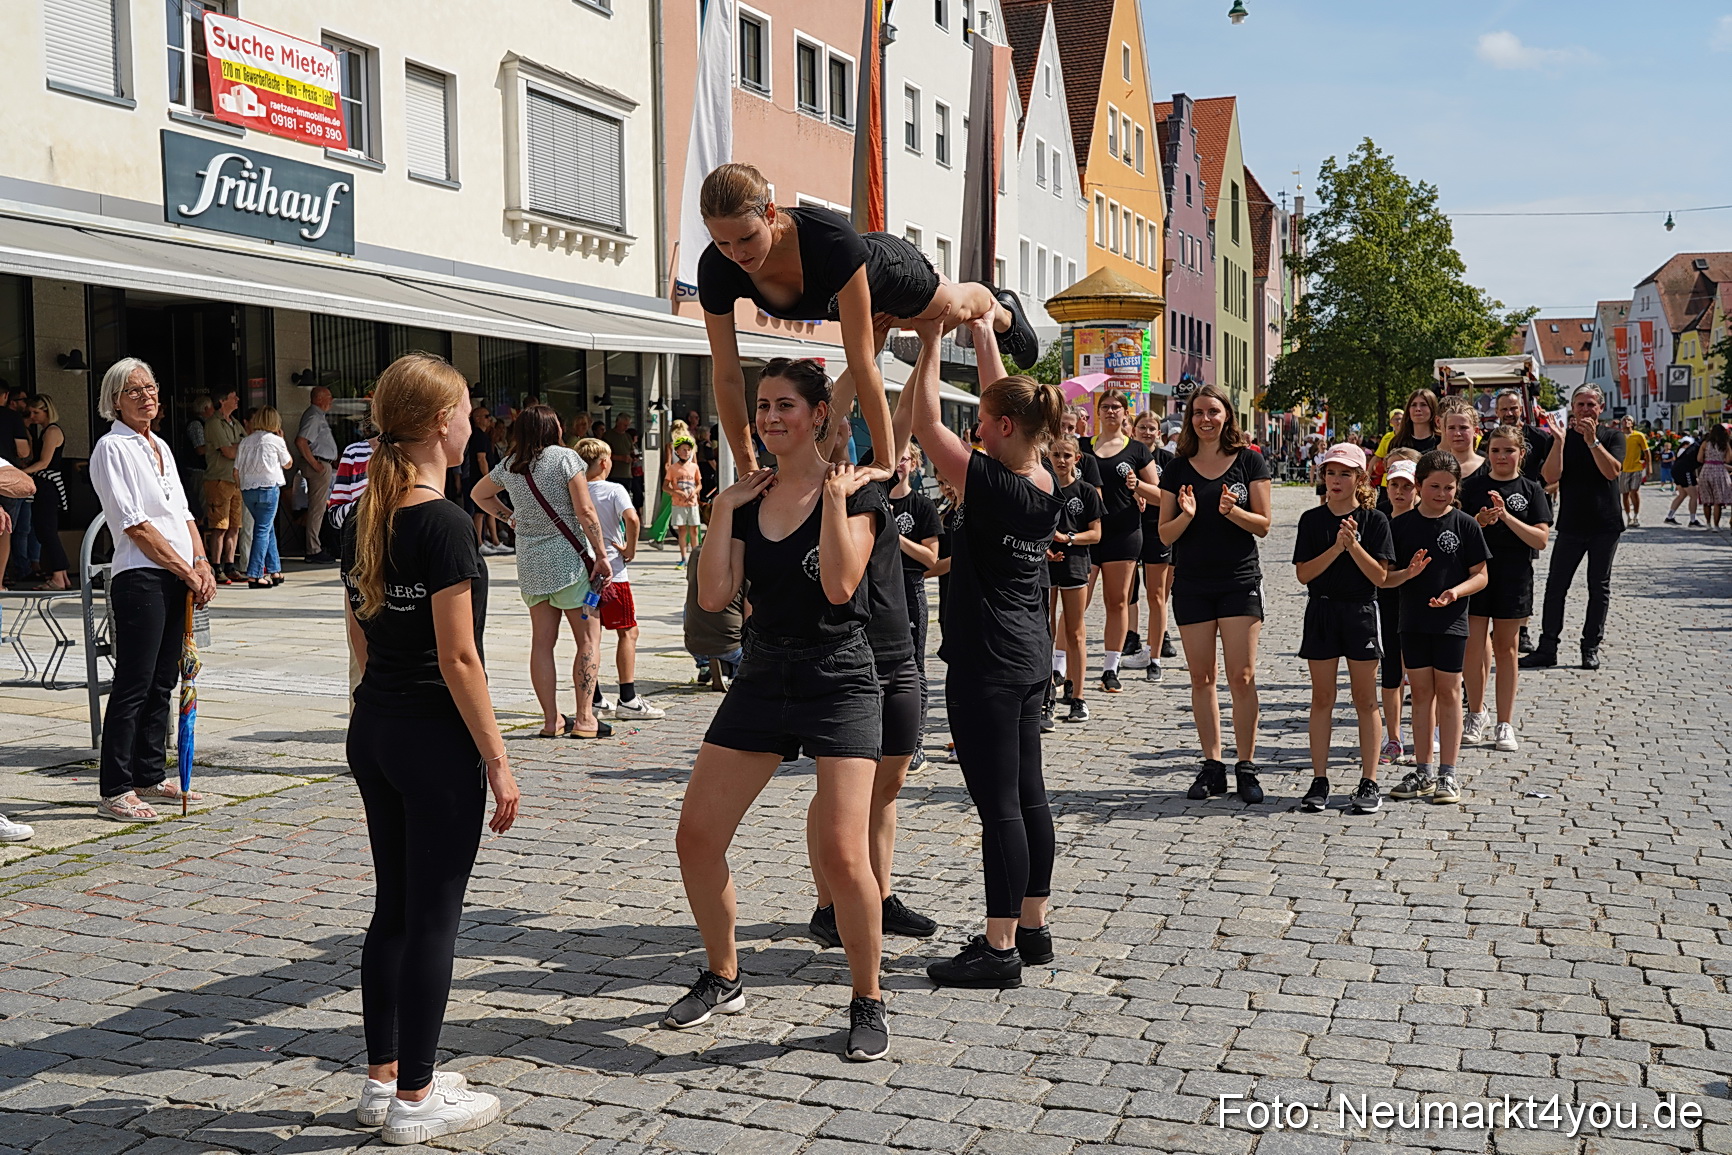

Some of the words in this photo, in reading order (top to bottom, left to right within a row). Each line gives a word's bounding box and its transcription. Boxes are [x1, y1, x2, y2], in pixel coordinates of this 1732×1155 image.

[212, 26, 275, 62] Suche
[281, 45, 335, 82] Mieter!
[222, 61, 234, 78] 270
[269, 100, 341, 127] raetzer-immobilien.de
[271, 112, 298, 131] 09181
[305, 122, 323, 138] 509
[324, 127, 343, 142] 390
[1107, 355, 1141, 368] VOLKSFEST
[1641, 340, 1655, 372] SALE
